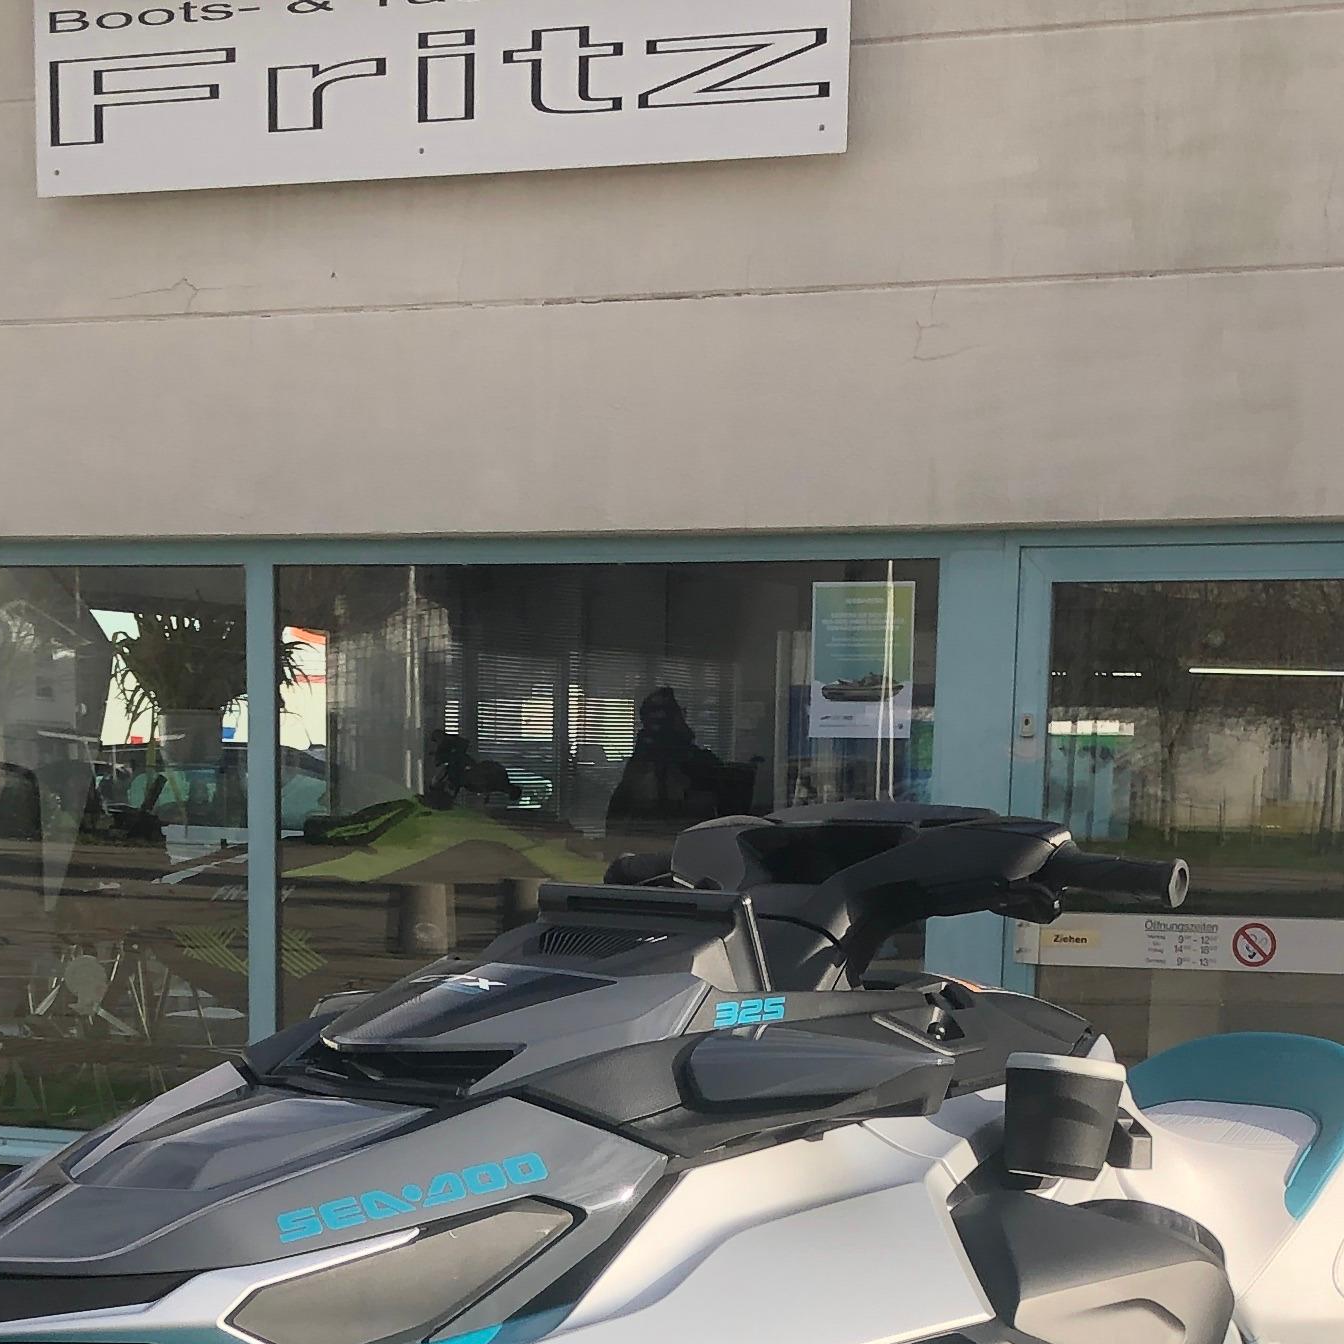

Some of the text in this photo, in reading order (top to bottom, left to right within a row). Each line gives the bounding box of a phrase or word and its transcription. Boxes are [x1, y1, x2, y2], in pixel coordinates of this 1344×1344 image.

[49, 0, 261, 34] Boots-
[49, 26, 830, 147] Fritz
[713, 996, 786, 1029] 325
